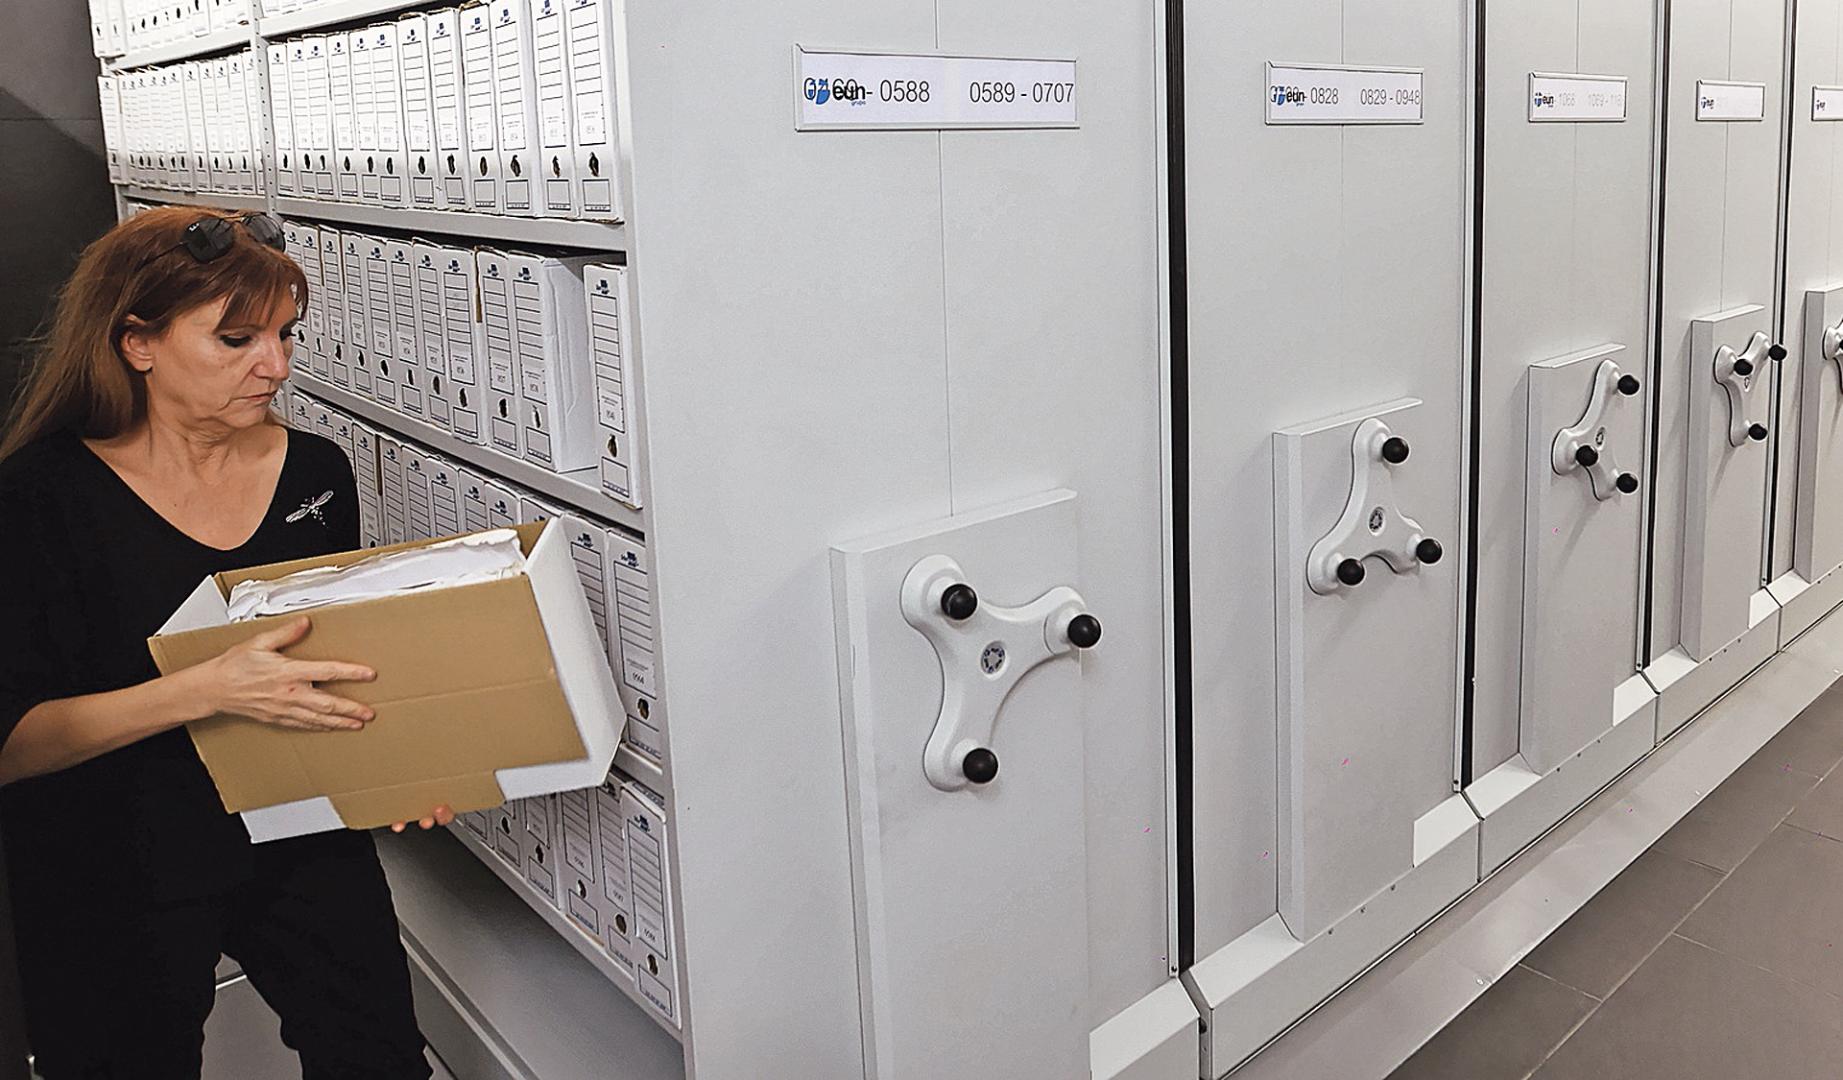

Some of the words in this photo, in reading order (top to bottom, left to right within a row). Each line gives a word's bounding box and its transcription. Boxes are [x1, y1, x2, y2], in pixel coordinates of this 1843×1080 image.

[880, 79, 930, 102] 0588
[969, 81, 1015, 103] 0589
[1032, 82, 1075, 103] 0707
[1310, 87, 1339, 105] 0828
[1360, 88, 1387, 105] 0829
[1395, 89, 1421, 105] 0948
